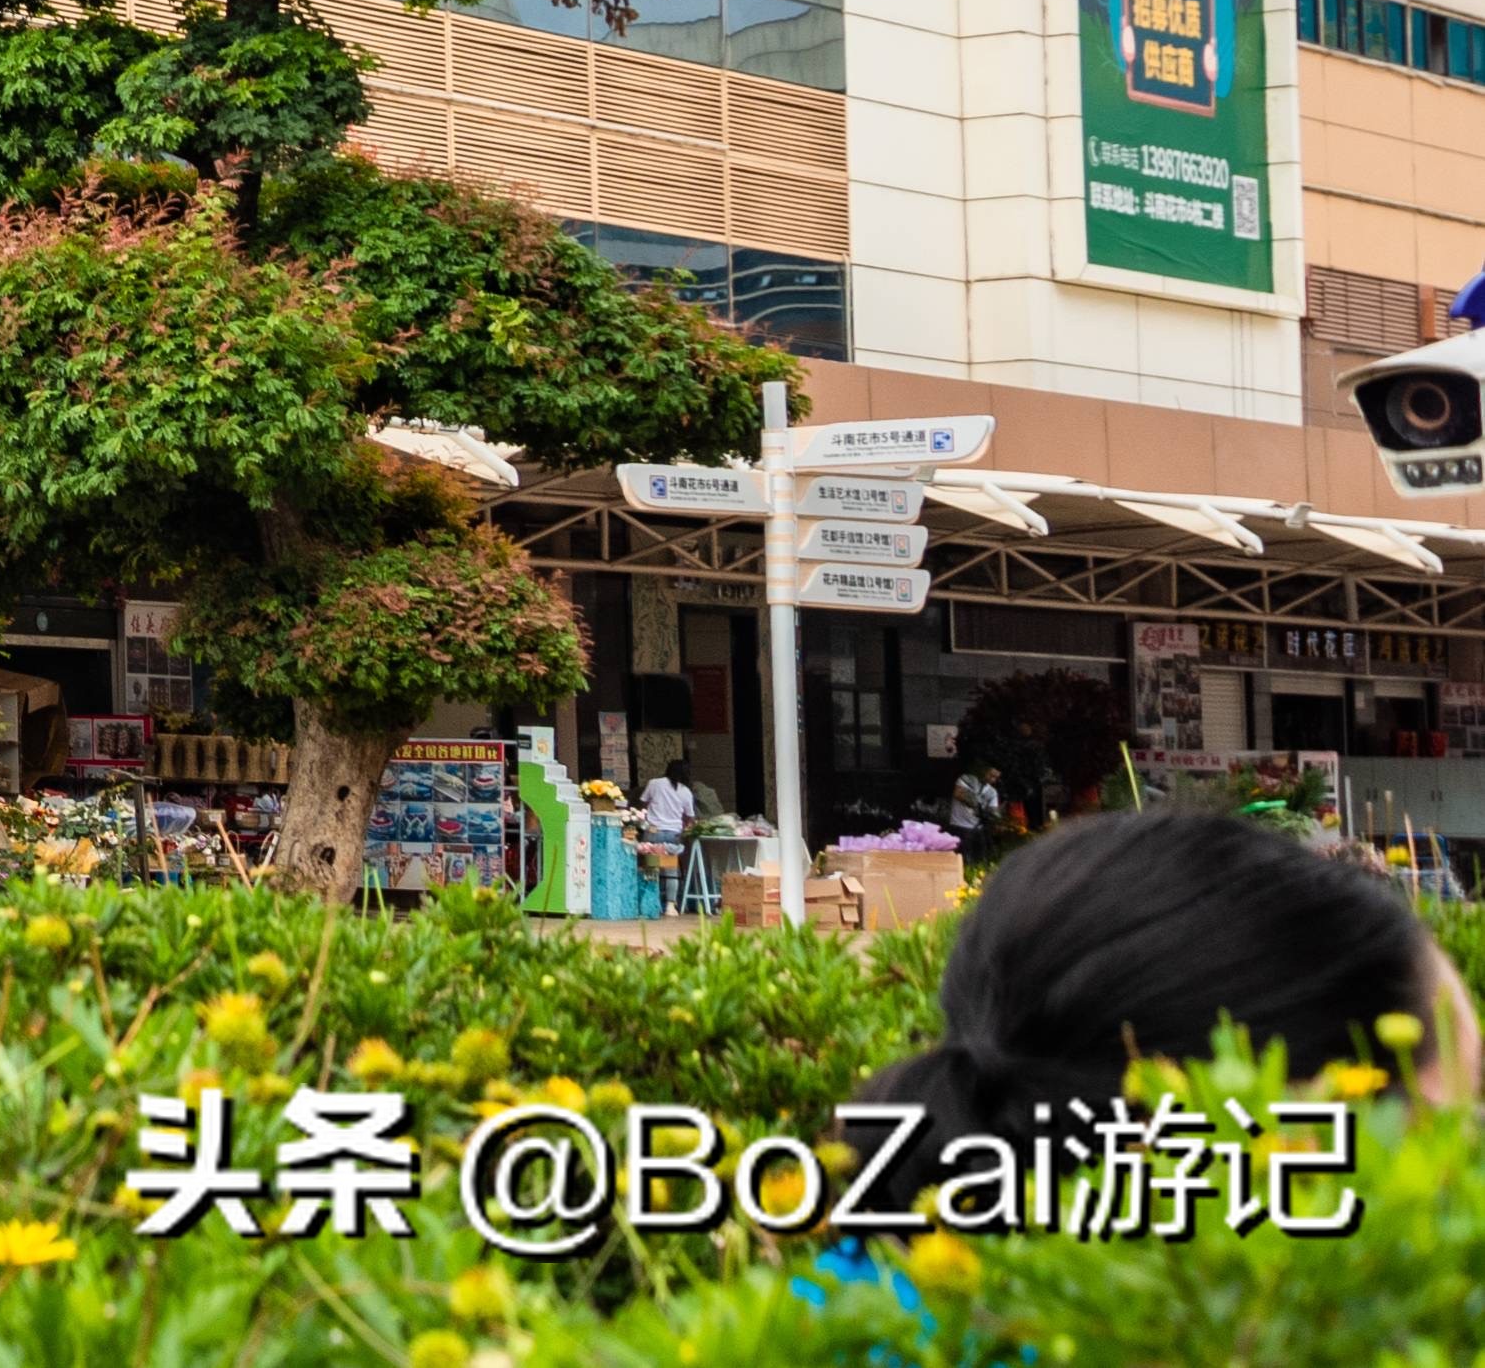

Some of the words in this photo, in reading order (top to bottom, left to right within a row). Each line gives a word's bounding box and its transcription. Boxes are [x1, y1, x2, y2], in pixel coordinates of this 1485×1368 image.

[1143, 40, 1195, 89] 供应商
[831, 430, 927, 447] 斗南花市5号通道
[669, 476, 739, 493] 斗南花市6号通道
